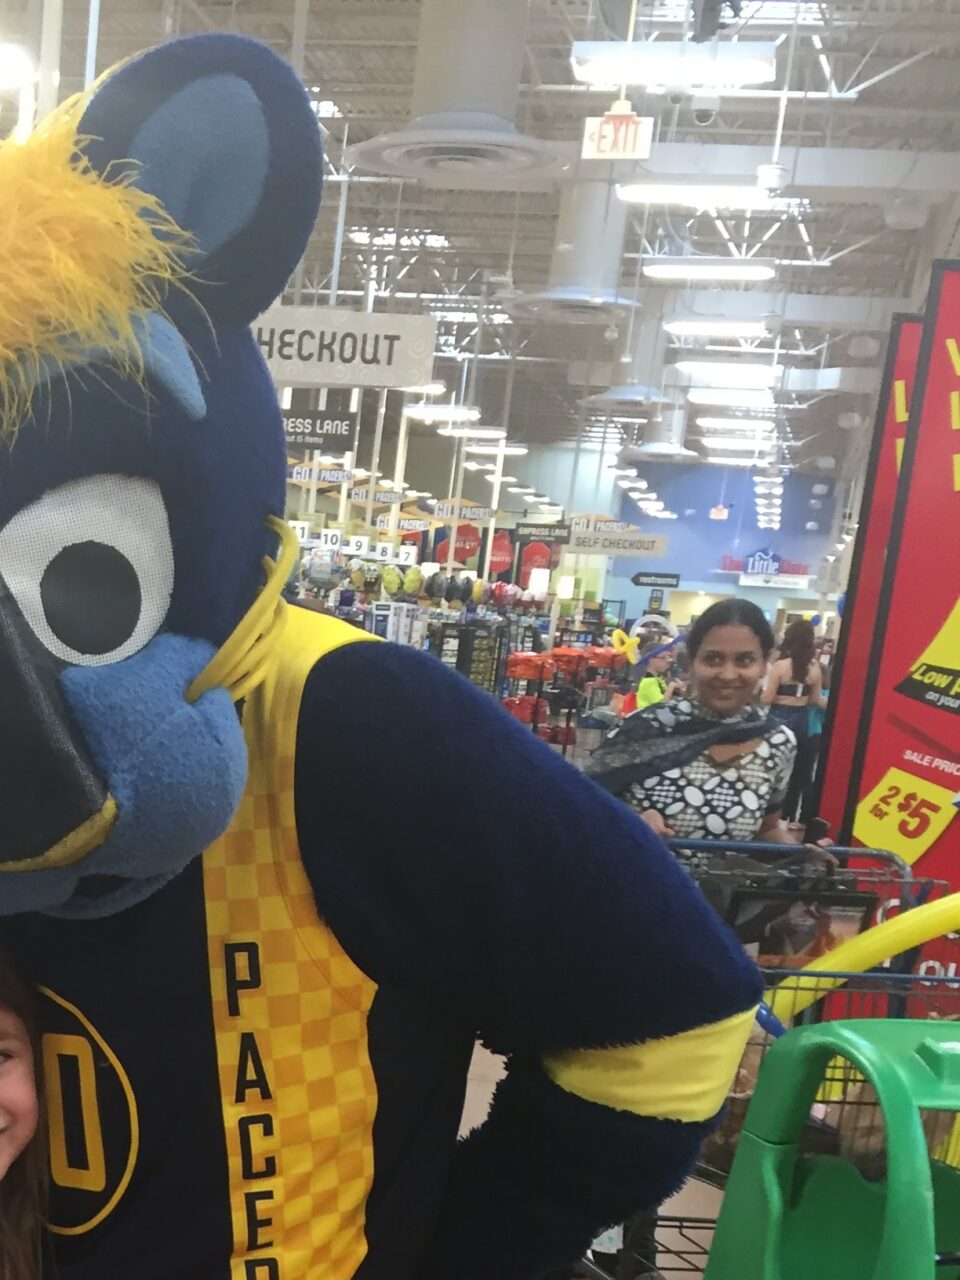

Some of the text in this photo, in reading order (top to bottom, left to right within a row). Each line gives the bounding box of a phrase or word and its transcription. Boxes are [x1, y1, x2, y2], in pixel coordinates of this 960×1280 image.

[596, 119, 641, 153] EXIT
[257, 327, 401, 365] HECKOUT
[283, 418, 350, 435] RESS LANE
[323, 533, 339, 546] 10
[355, 540, 363, 551] 9
[575, 536, 657, 551] SELF CHECKOUT
[380, 546, 388, 557] 8
[404, 551, 411, 562] 7
[912, 665, 955, 688] Low
[925, 691, 940, 702] on
[903, 749, 933, 767] SALE
[869, 803, 889, 821] for
[879, 785, 942, 829] 2 $5
